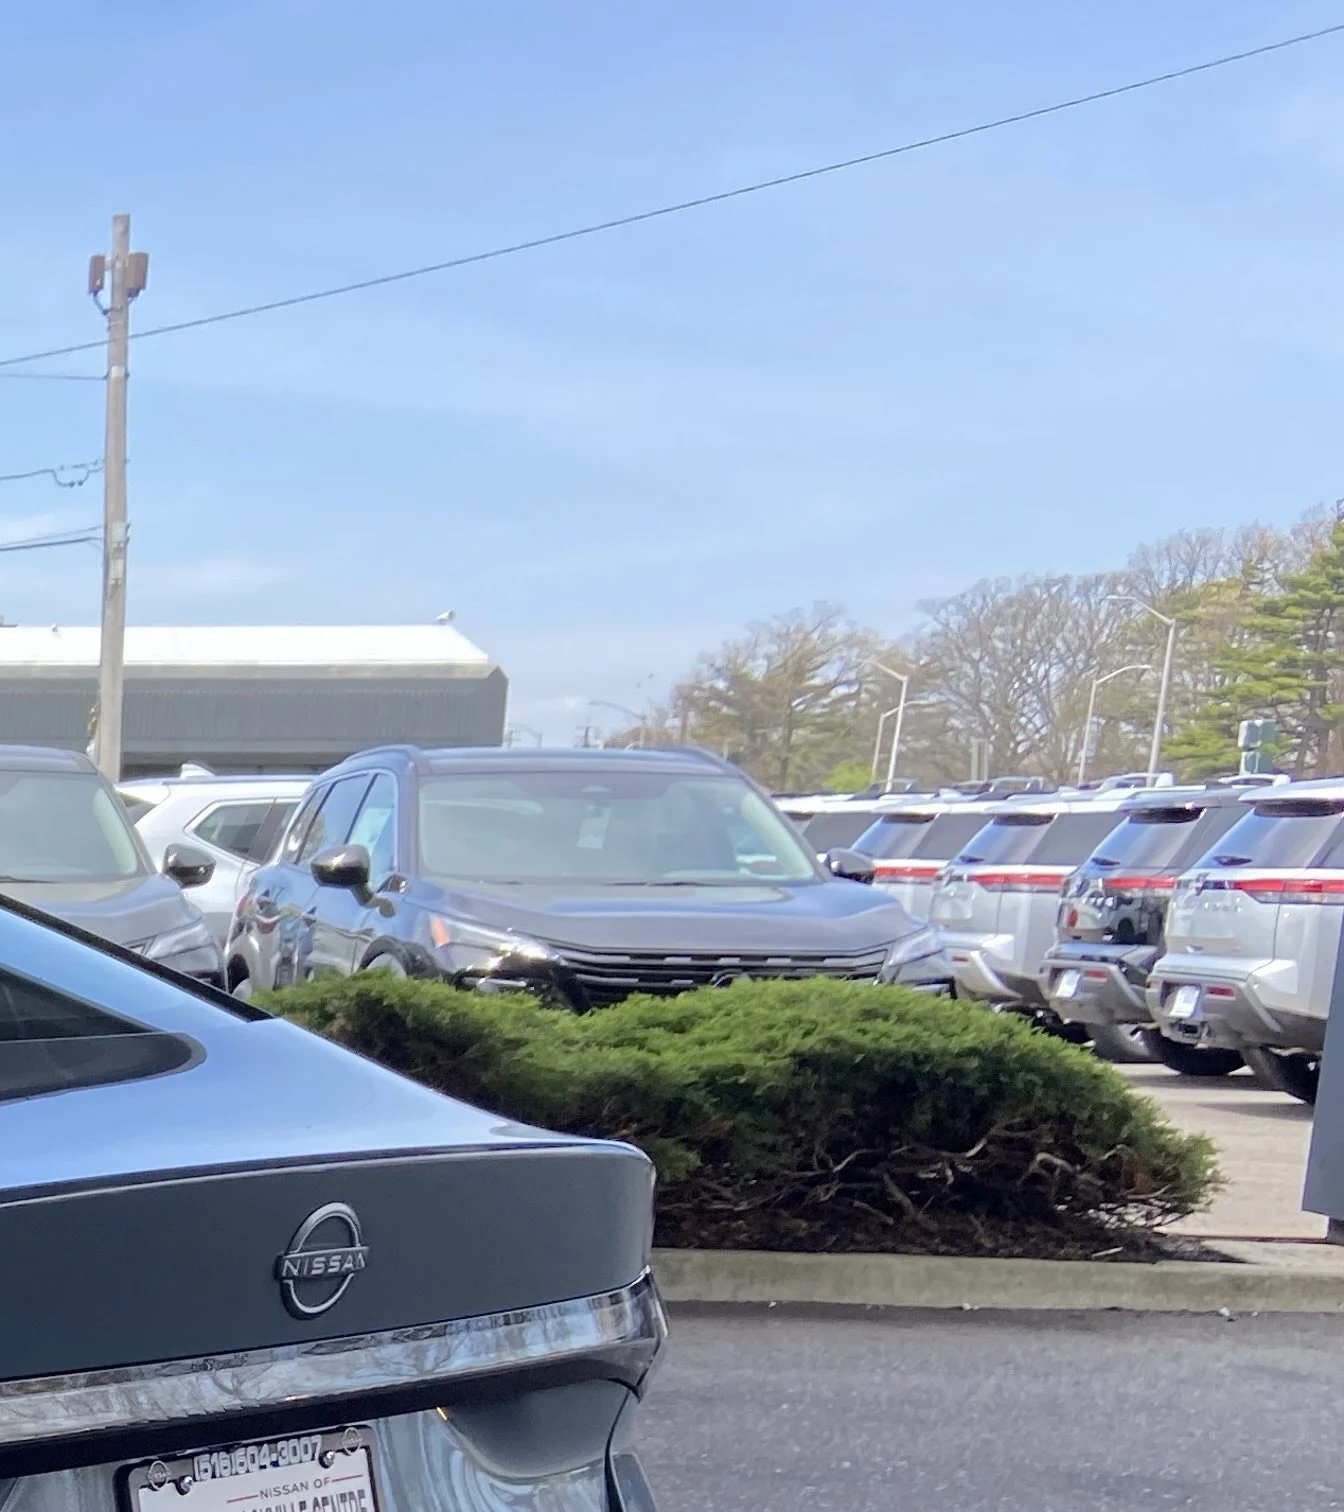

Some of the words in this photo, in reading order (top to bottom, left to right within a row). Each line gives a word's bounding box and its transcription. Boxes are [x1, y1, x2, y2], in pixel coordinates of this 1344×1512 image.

[281, 1251, 367, 1277] NISSAN
[260, 1483, 309, 1499] NISSAN
[314, 1476, 330, 1489] OF
